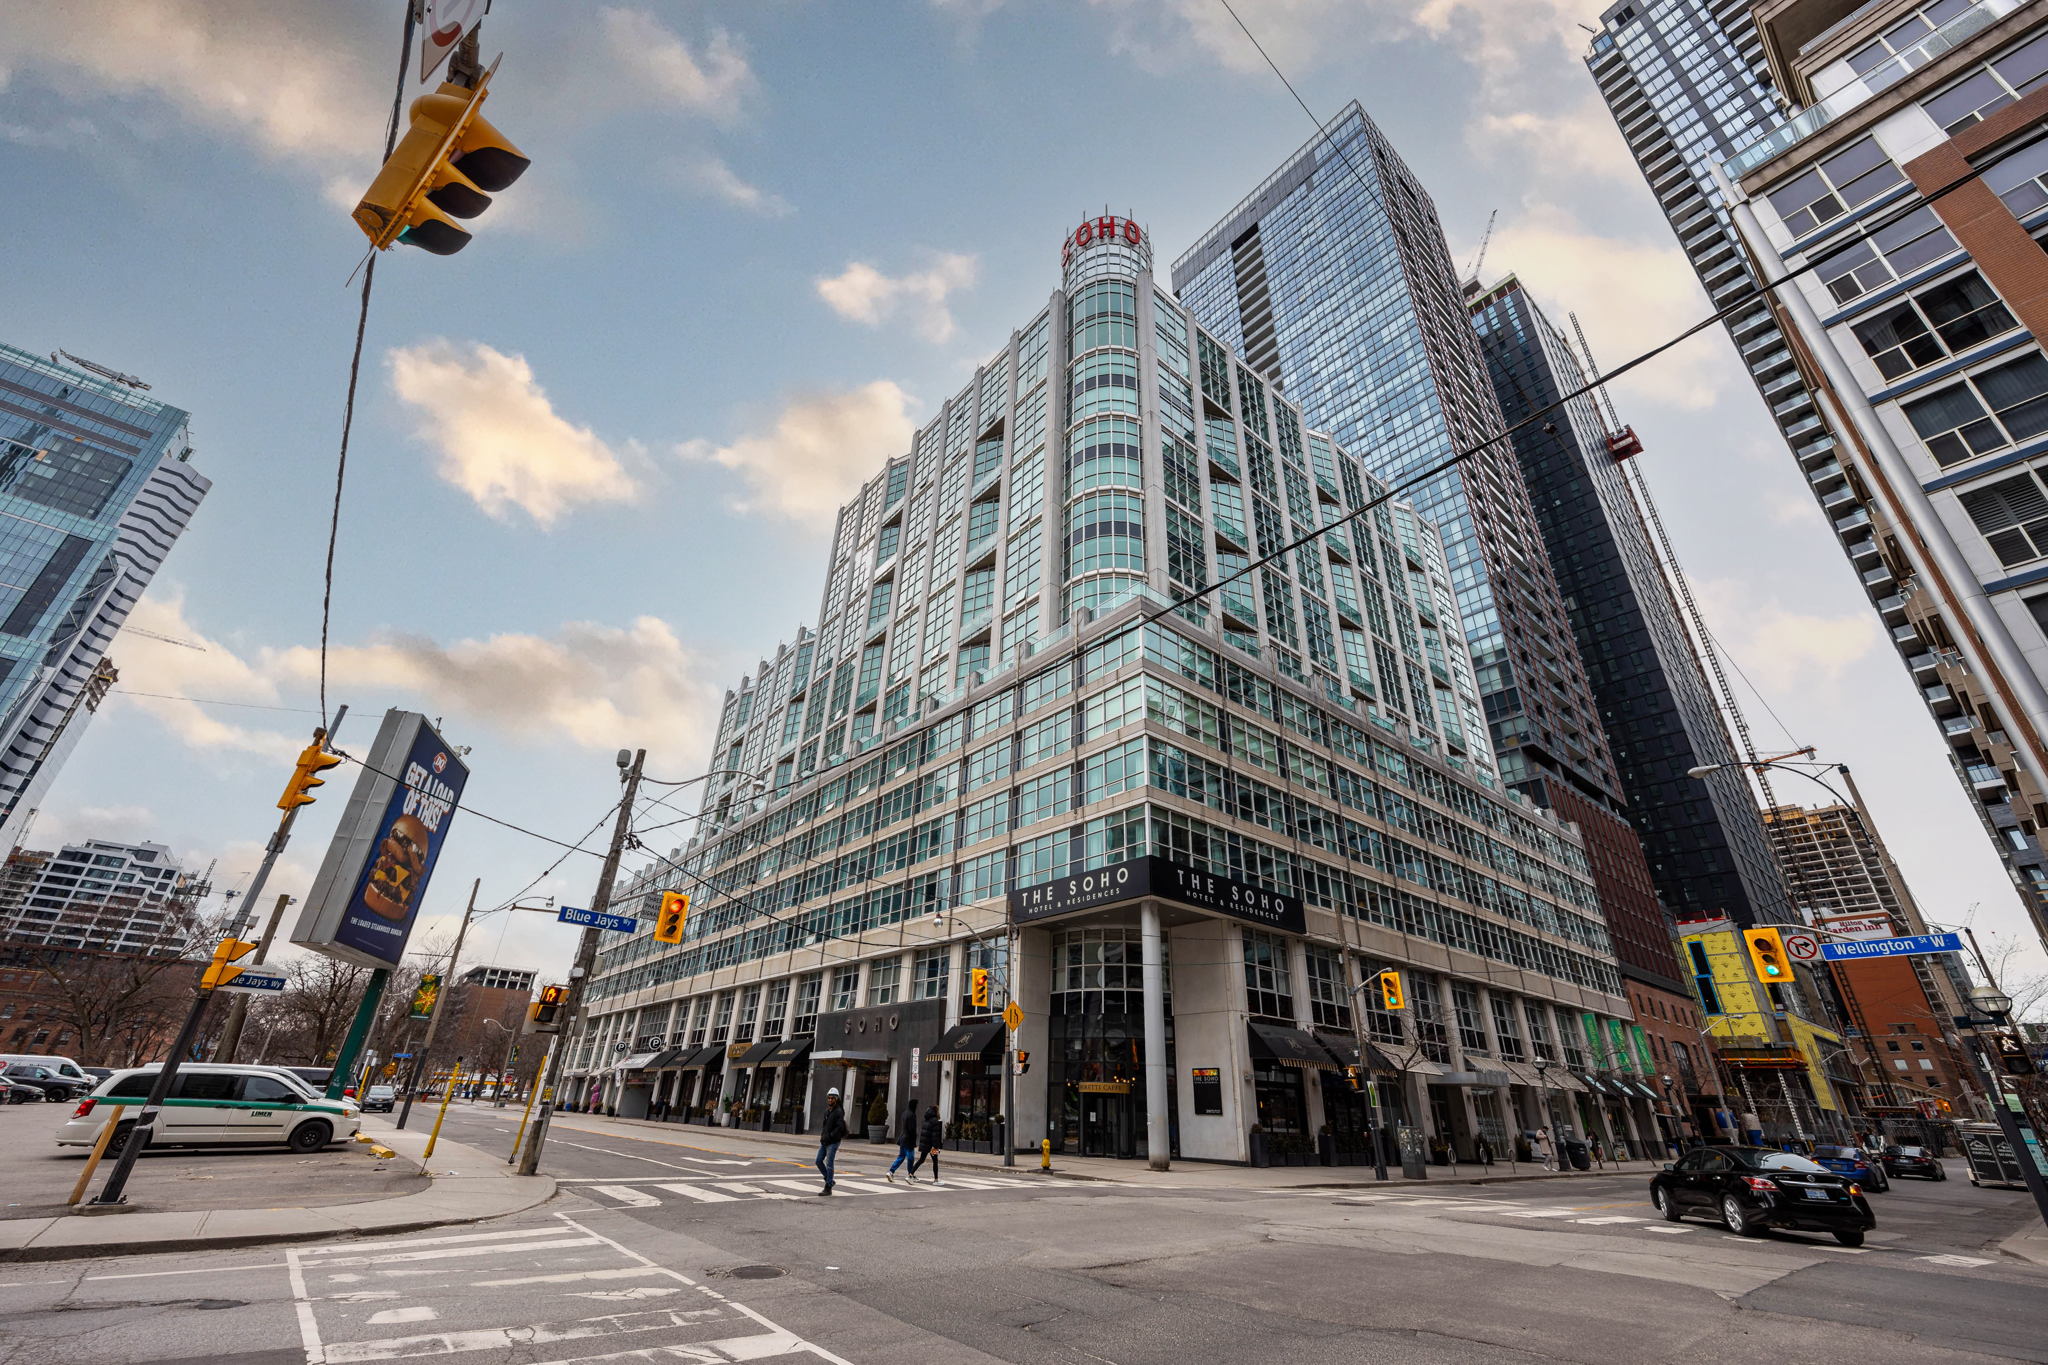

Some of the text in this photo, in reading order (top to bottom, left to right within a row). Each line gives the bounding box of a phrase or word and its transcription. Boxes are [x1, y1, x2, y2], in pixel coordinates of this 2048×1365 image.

[404, 761, 428, 793] GET
[429, 778, 454, 812] LOAD
[403, 788, 442, 832] OF THIS!
[1022, 867, 1129, 907] THE SOHO
[1028, 904, 1053, 915] HOTEL
[1066, 887, 1121, 906] RESIDENCES
[1177, 869, 1284, 913] THE SOHO
[565, 908, 632, 929] Blue Jays Wy
[1186, 889, 1214, 904] HOTEL
[1229, 902, 1280, 921] RESIDENCES
[1833, 935, 1946, 956] Wellington St W
[246, 976, 268, 988] Jays
[271, 980, 282, 989] Wy
[844, 1013, 899, 1034] SOHO
